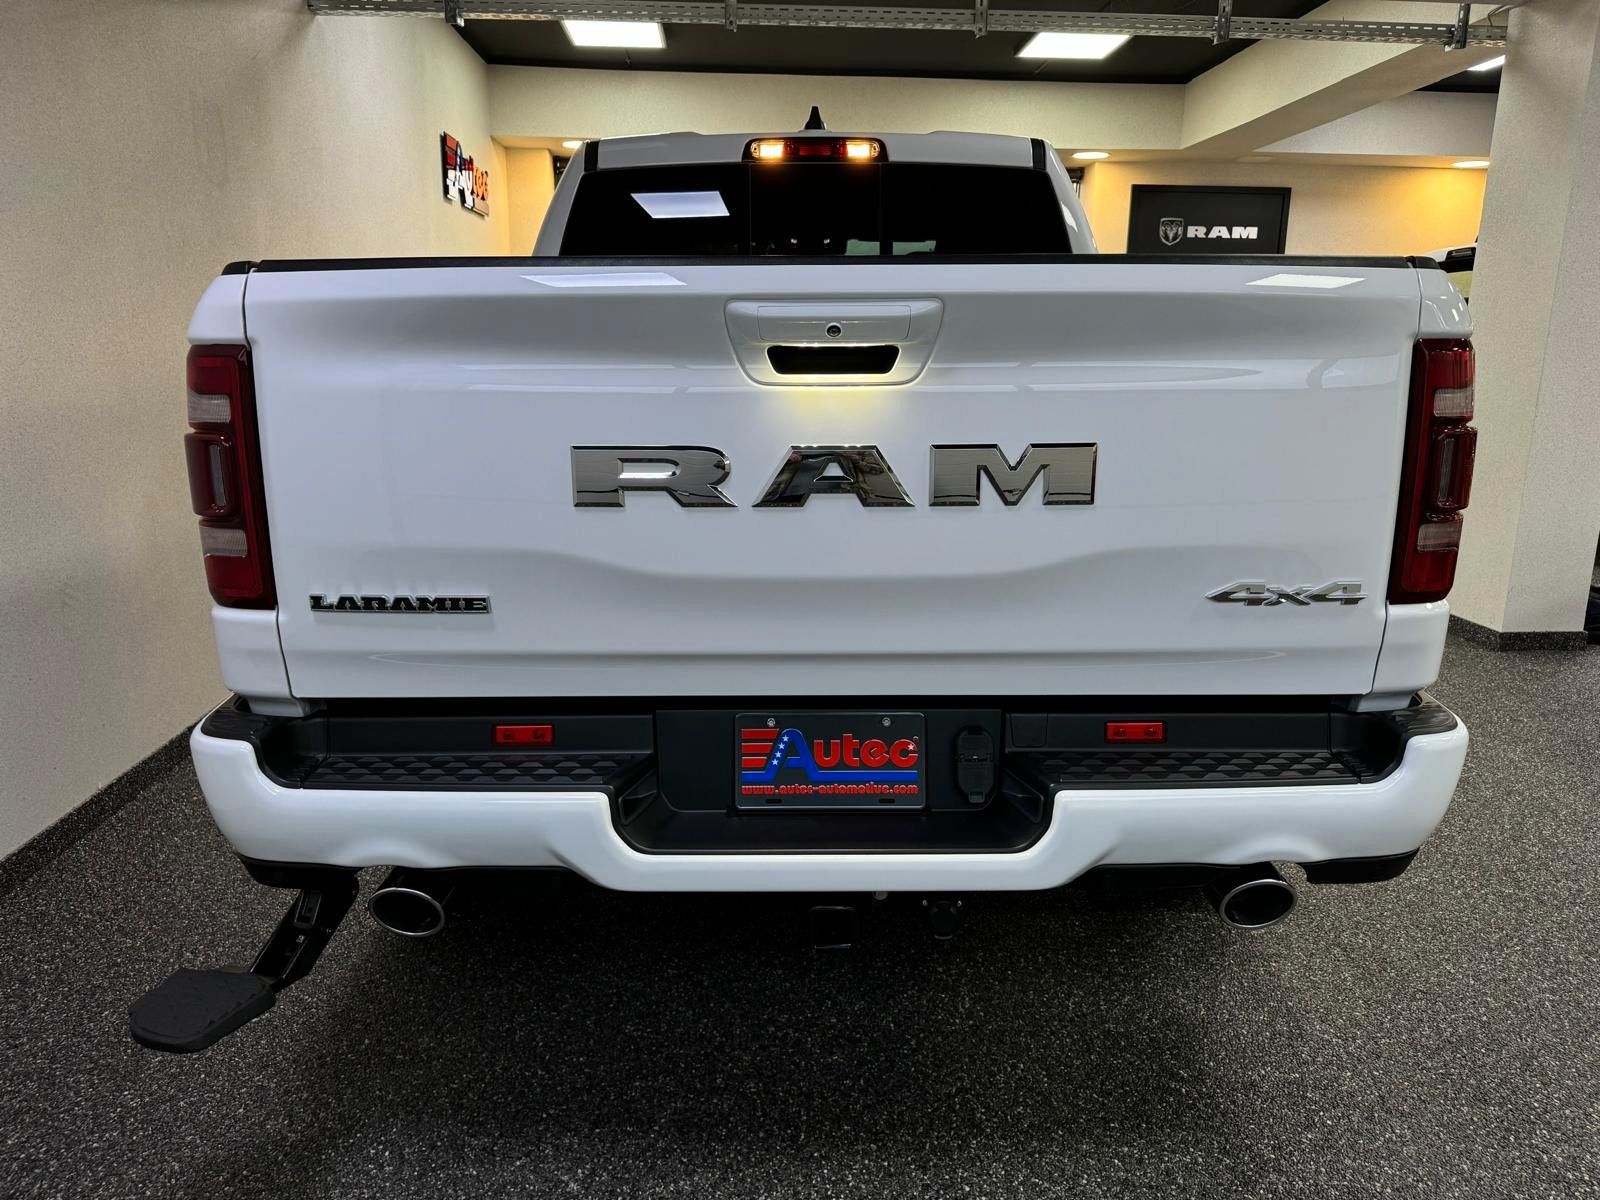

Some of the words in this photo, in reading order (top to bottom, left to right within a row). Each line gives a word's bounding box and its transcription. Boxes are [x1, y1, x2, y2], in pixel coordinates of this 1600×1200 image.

[1186, 225, 1258, 239] RAM
[571, 443, 1098, 507] RAM
[309, 593, 491, 613] LARAMIE
[764, 728, 918, 768] Autec
[741, 782, 918, 794] www.autec-automotive.com
